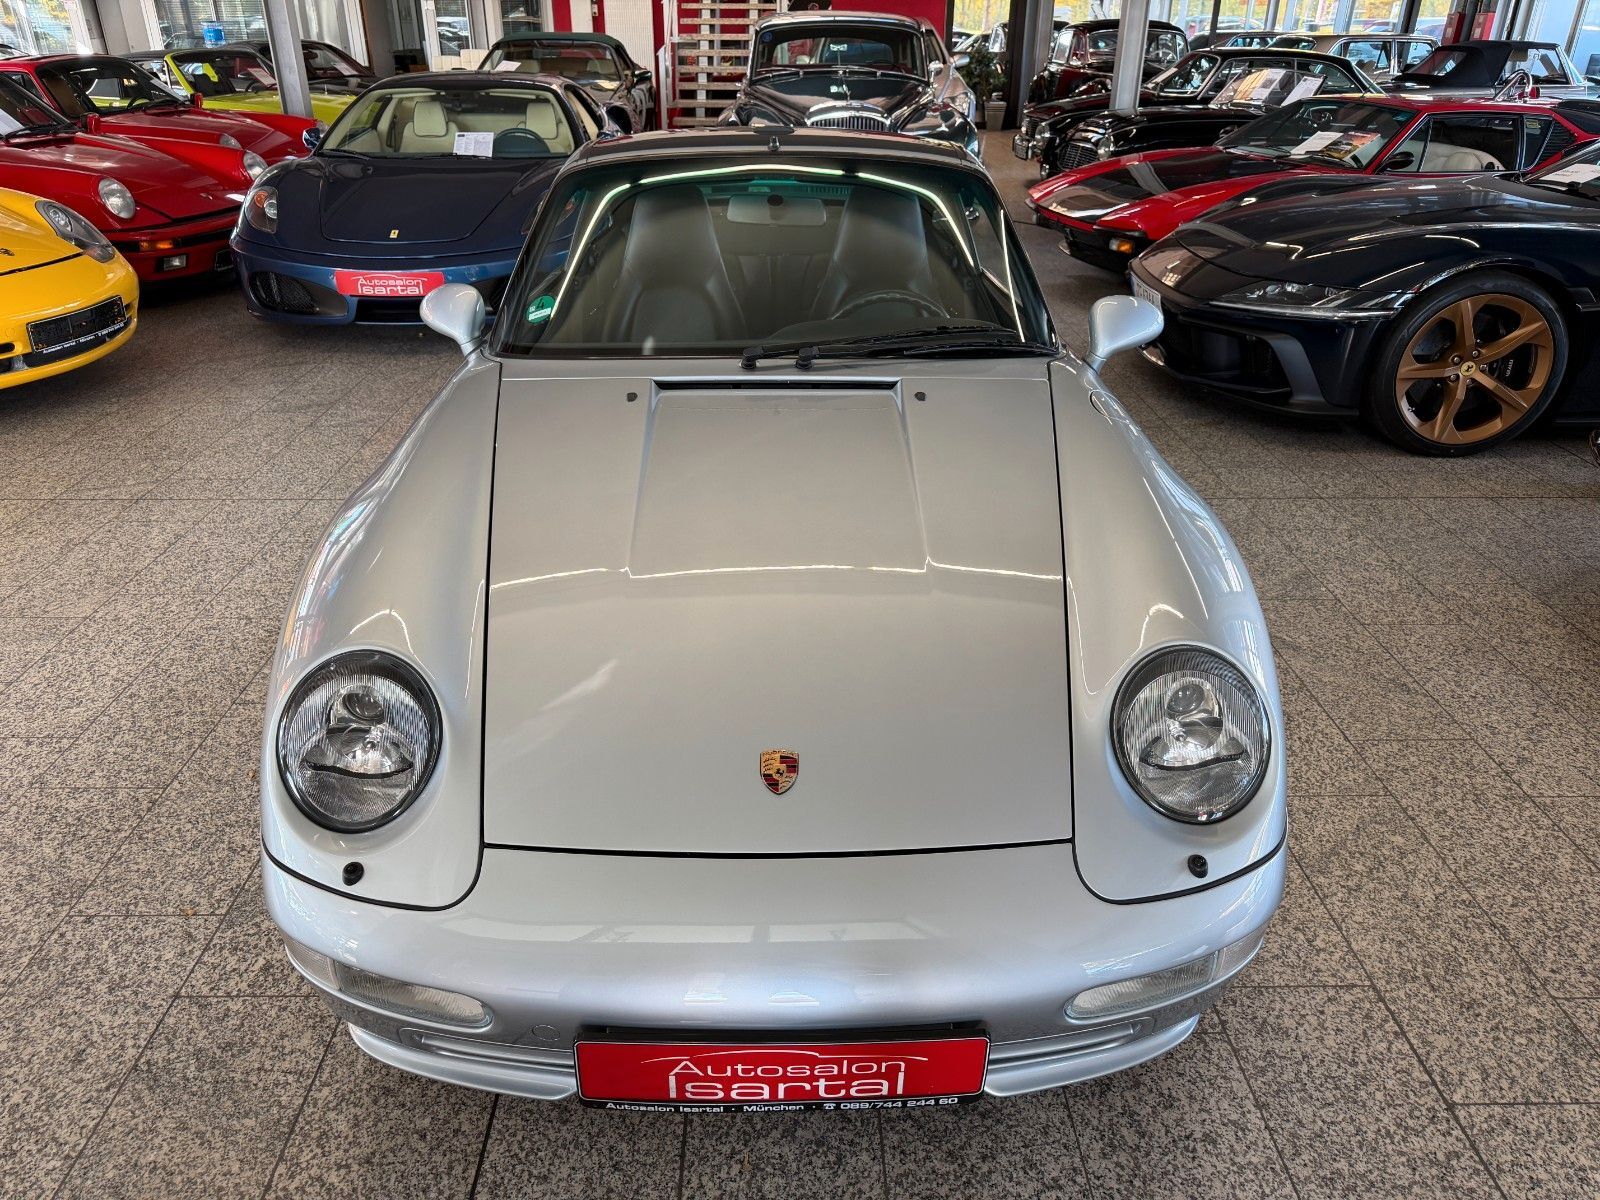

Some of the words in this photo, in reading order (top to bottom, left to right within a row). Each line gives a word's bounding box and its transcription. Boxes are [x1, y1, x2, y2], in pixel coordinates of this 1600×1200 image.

[358, 278, 423, 286] Autosalon
[358, 280, 424, 294] Isartal
[536, 297, 545, 309] 4
[668, 1059, 905, 1077] Autosalon
[668, 1072, 905, 1100] Isartal
[605, 1102, 675, 1112] Autosalon
[679, 1105, 724, 1113] Isartal
[743, 1103, 804, 1112] München
[840, 1101, 903, 1110] 089/744
[906, 1099, 935, 1107] 244
[939, 1097, 958, 1105] 60
